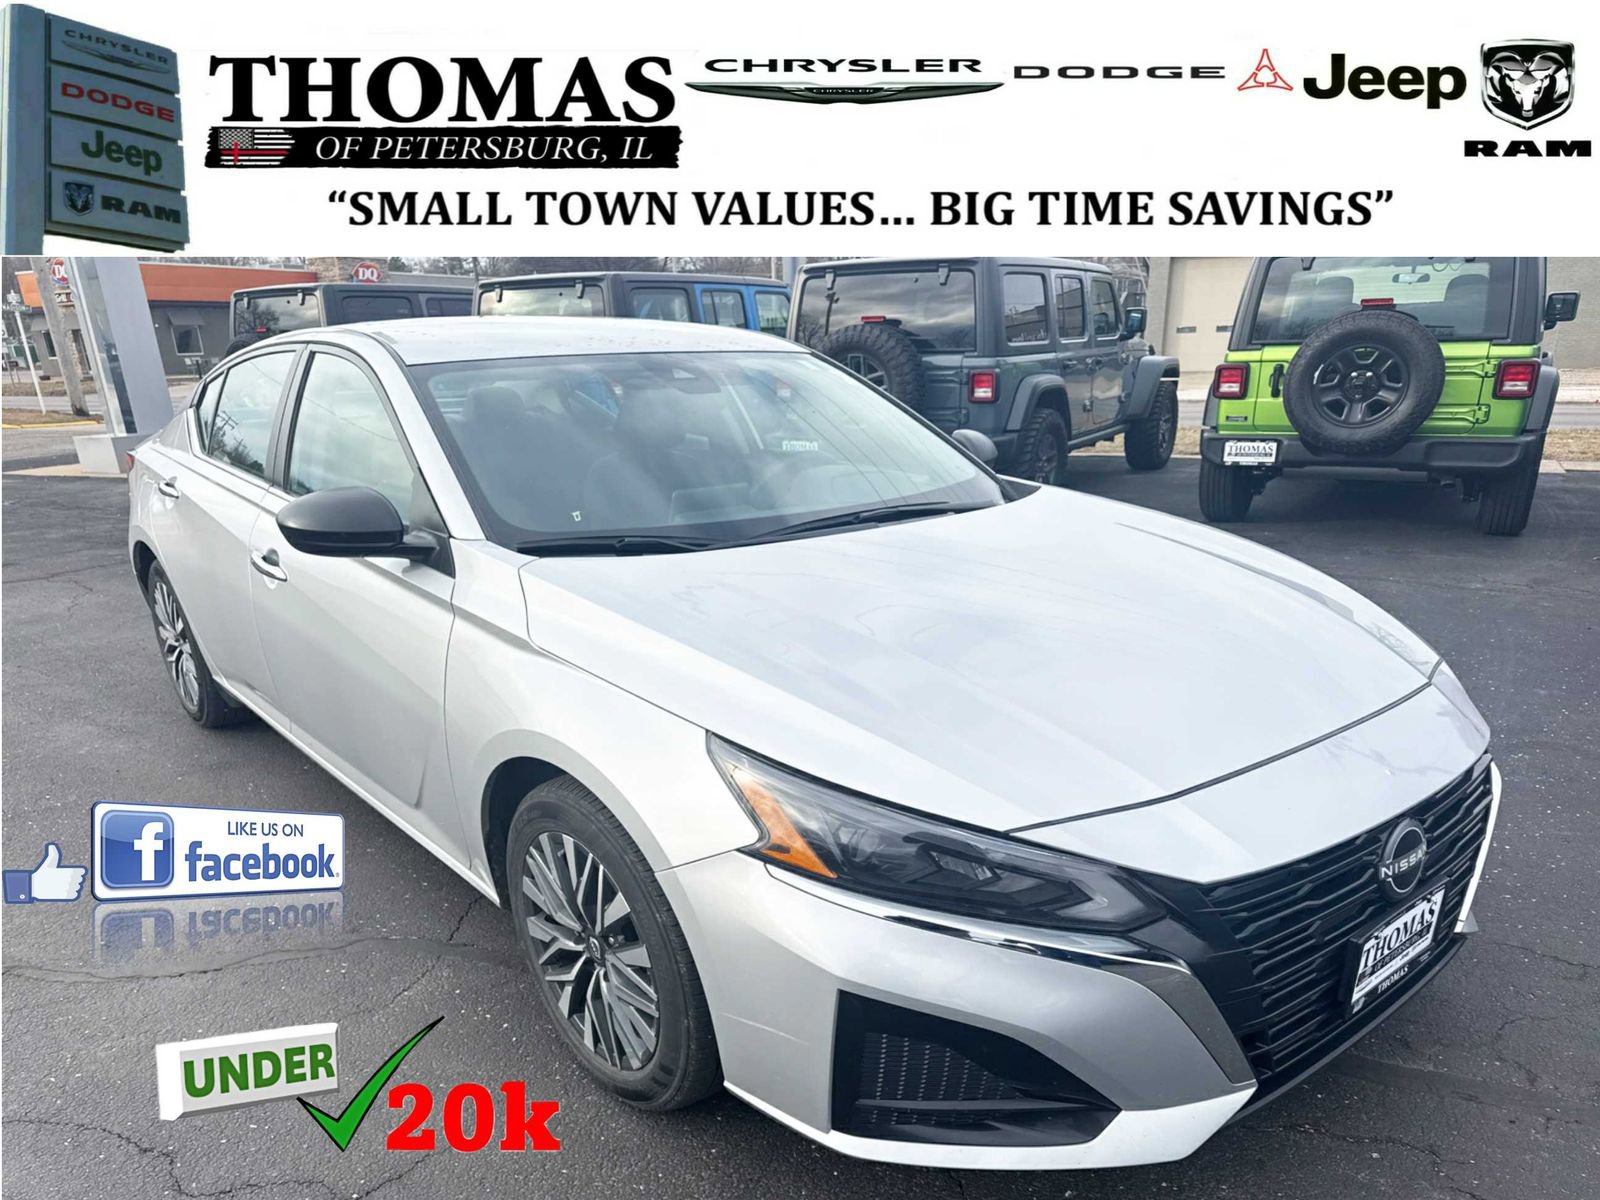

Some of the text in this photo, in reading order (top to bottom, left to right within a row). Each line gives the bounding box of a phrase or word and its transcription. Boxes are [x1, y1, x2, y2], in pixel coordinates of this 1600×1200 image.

[358, 267, 378, 281] DQ
[1229, 445, 1273, 453] THOMAS
[1363, 901, 1437, 969] THOMAS
